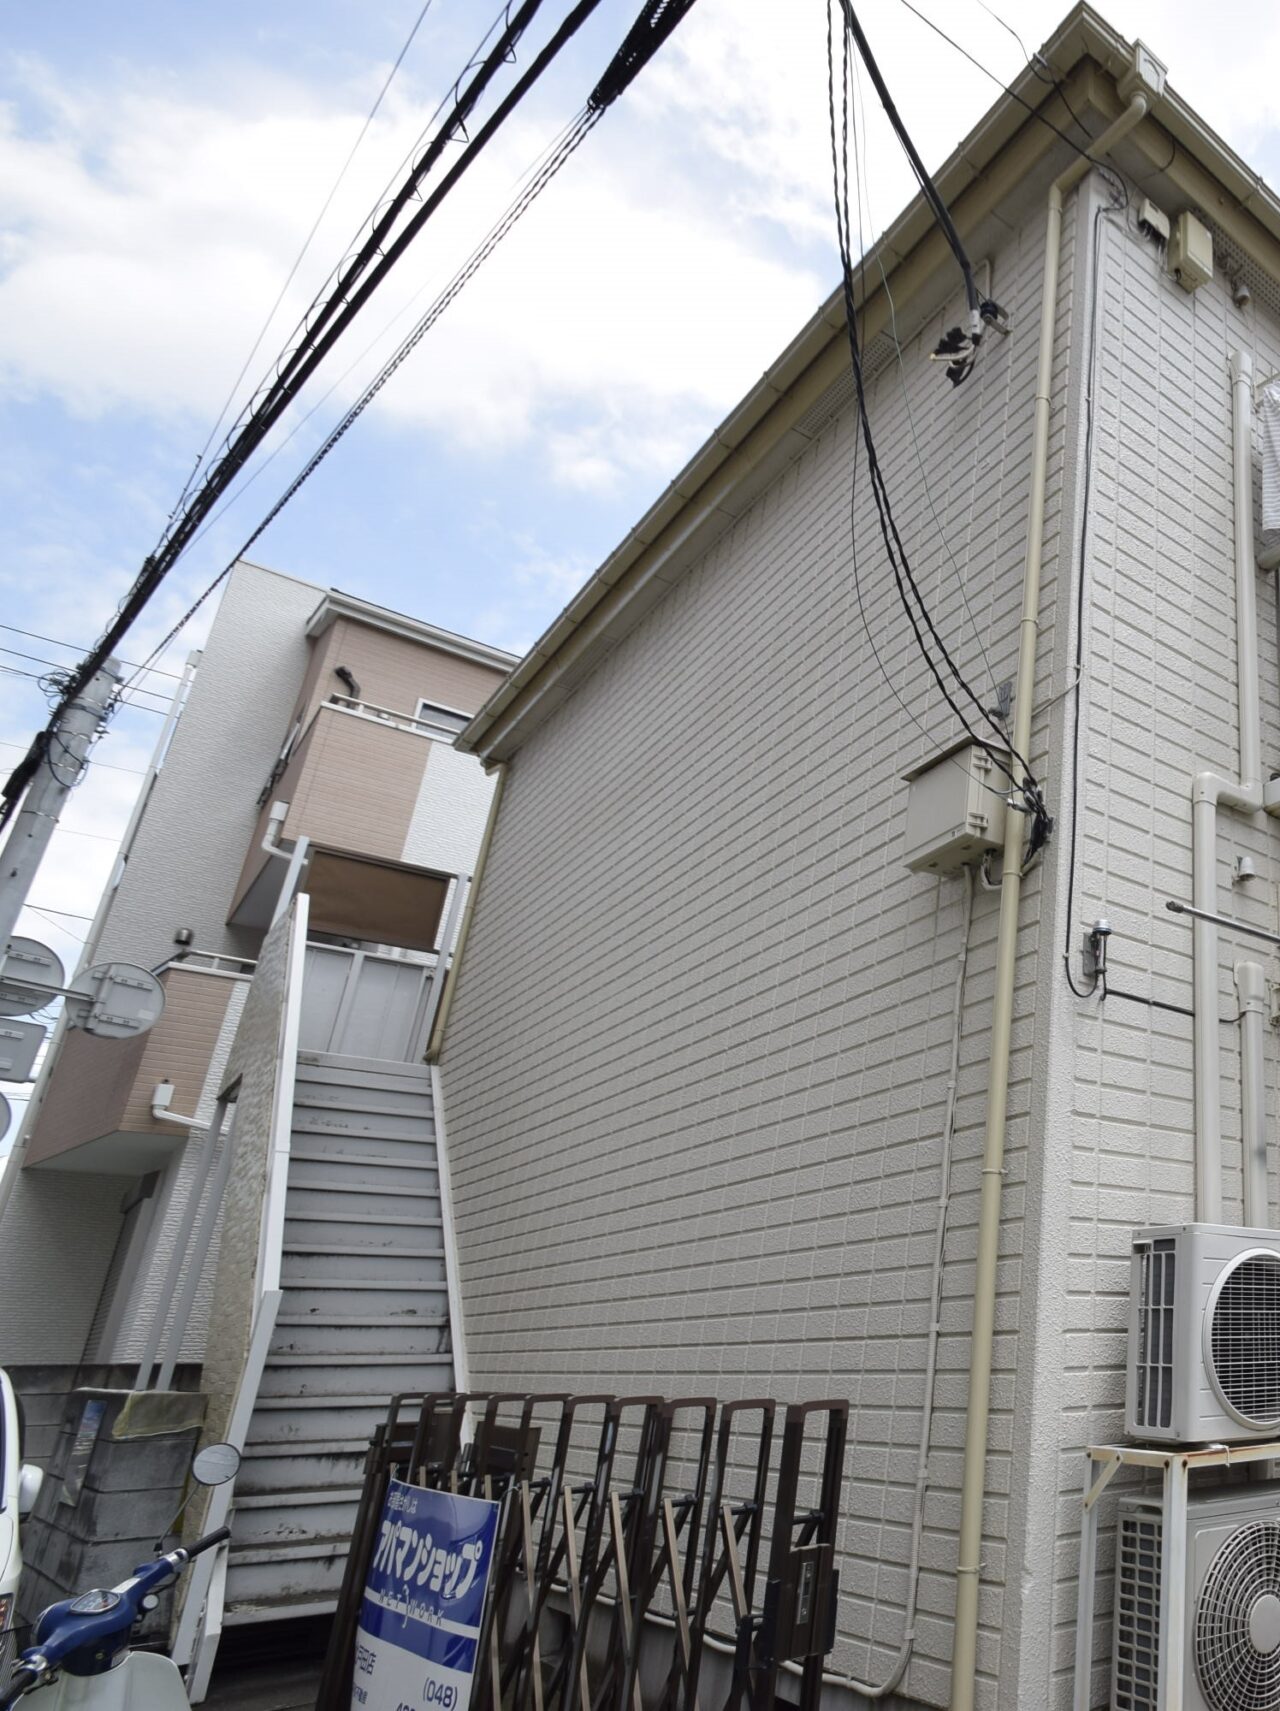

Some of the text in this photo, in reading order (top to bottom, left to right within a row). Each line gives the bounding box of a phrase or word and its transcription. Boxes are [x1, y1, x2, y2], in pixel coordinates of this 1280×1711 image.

[373, 1520, 483, 1599] アパマンショップ
[423, 1677, 458, 1711] (048)
